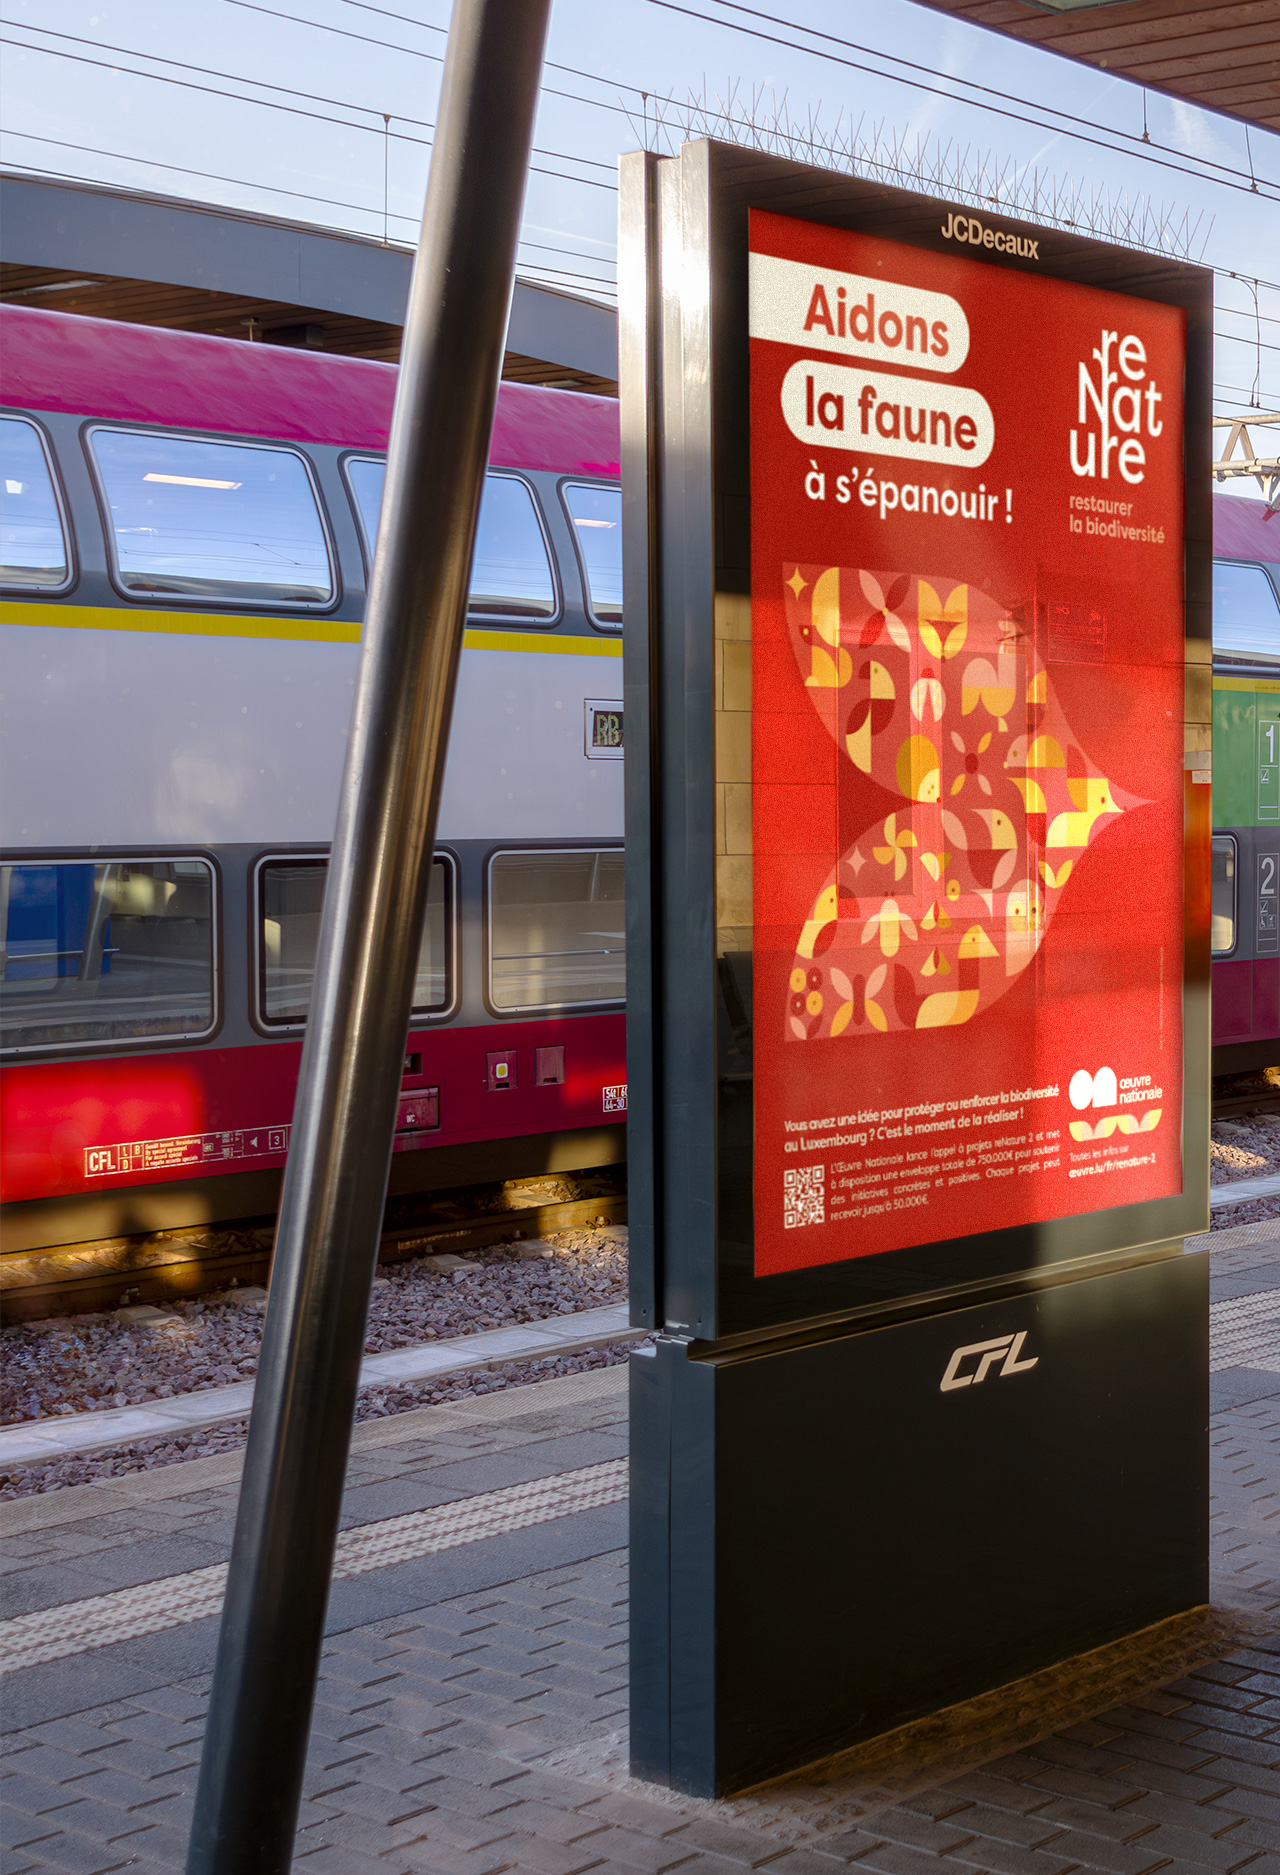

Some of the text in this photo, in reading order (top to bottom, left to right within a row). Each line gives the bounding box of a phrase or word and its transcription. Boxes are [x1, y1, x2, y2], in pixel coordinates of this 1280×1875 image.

[941, 213, 1039, 260] JCDecaux
[803, 283, 949, 357] Aidons
[806, 375, 978, 451] la faune
[805, 459, 1013, 523] à s’épanouir !
[1069, 494, 1133, 517] restaurer
[1069, 514, 1165, 544] la biodiversité
[596, 714, 620, 745] RB
[1266, 725, 1274, 763] 1
[1261, 857, 1274, 894] 2
[1120, 1075, 1151, 1090] œuvre
[1120, 1085, 1163, 1104] nationale
[784, 1084, 1060, 1132] Vous avez une idée pour protéger ou renforcer la biodiversité
[274, 1135, 280, 1145] 3
[784, 1141, 798, 1153] au
[800, 1133, 867, 1152] Luxembourg
[869, 1128, 875, 1140] ?
[876, 1125, 902, 1140] C'est
[904, 1123, 913, 1136] le
[914, 1118, 956, 1134] moment
[957, 1115, 970, 1128] de
[972, 1113, 982, 1125] la
[984, 1110, 1019, 1124] réaliser
[865, 1154, 904, 1168] Nationale
[906, 1150, 928, 1162] lance
[966, 1141, 992, 1154] projets
[1028, 1132, 1034, 1143] 2
[1035, 1132, 1044, 1141] et
[1046, 1129, 1060, 1139] met
[89, 1150, 116, 1172] CFL
[122, 1146, 127, 1157] L
[123, 1159, 129, 1170] D
[135, 1145, 140, 1155] B
[838, 1173, 881, 1189] disposition
[883, 1171, 898, 1181] une
[900, 1164, 940, 1177] enveloppe
[966, 1157, 976, 1167] de
[1015, 1149, 1031, 1161] pour
[1033, 1143, 1060, 1156] soutenir
[1069, 1152, 1091, 1162] Toutes
[1092, 1149, 1101, 1159] les
[830, 1195, 846, 1205] des
[851, 1188, 888, 1201] initiatives
[934, 1178, 944, 1187] et
[985, 1167, 1014, 1178] Chaque
[1018, 1161, 1040, 1174] projet
[1043, 1158, 1060, 1170] peut
[830, 1206, 862, 1221] recevoir
[940, 1330, 1039, 1392] CFL
